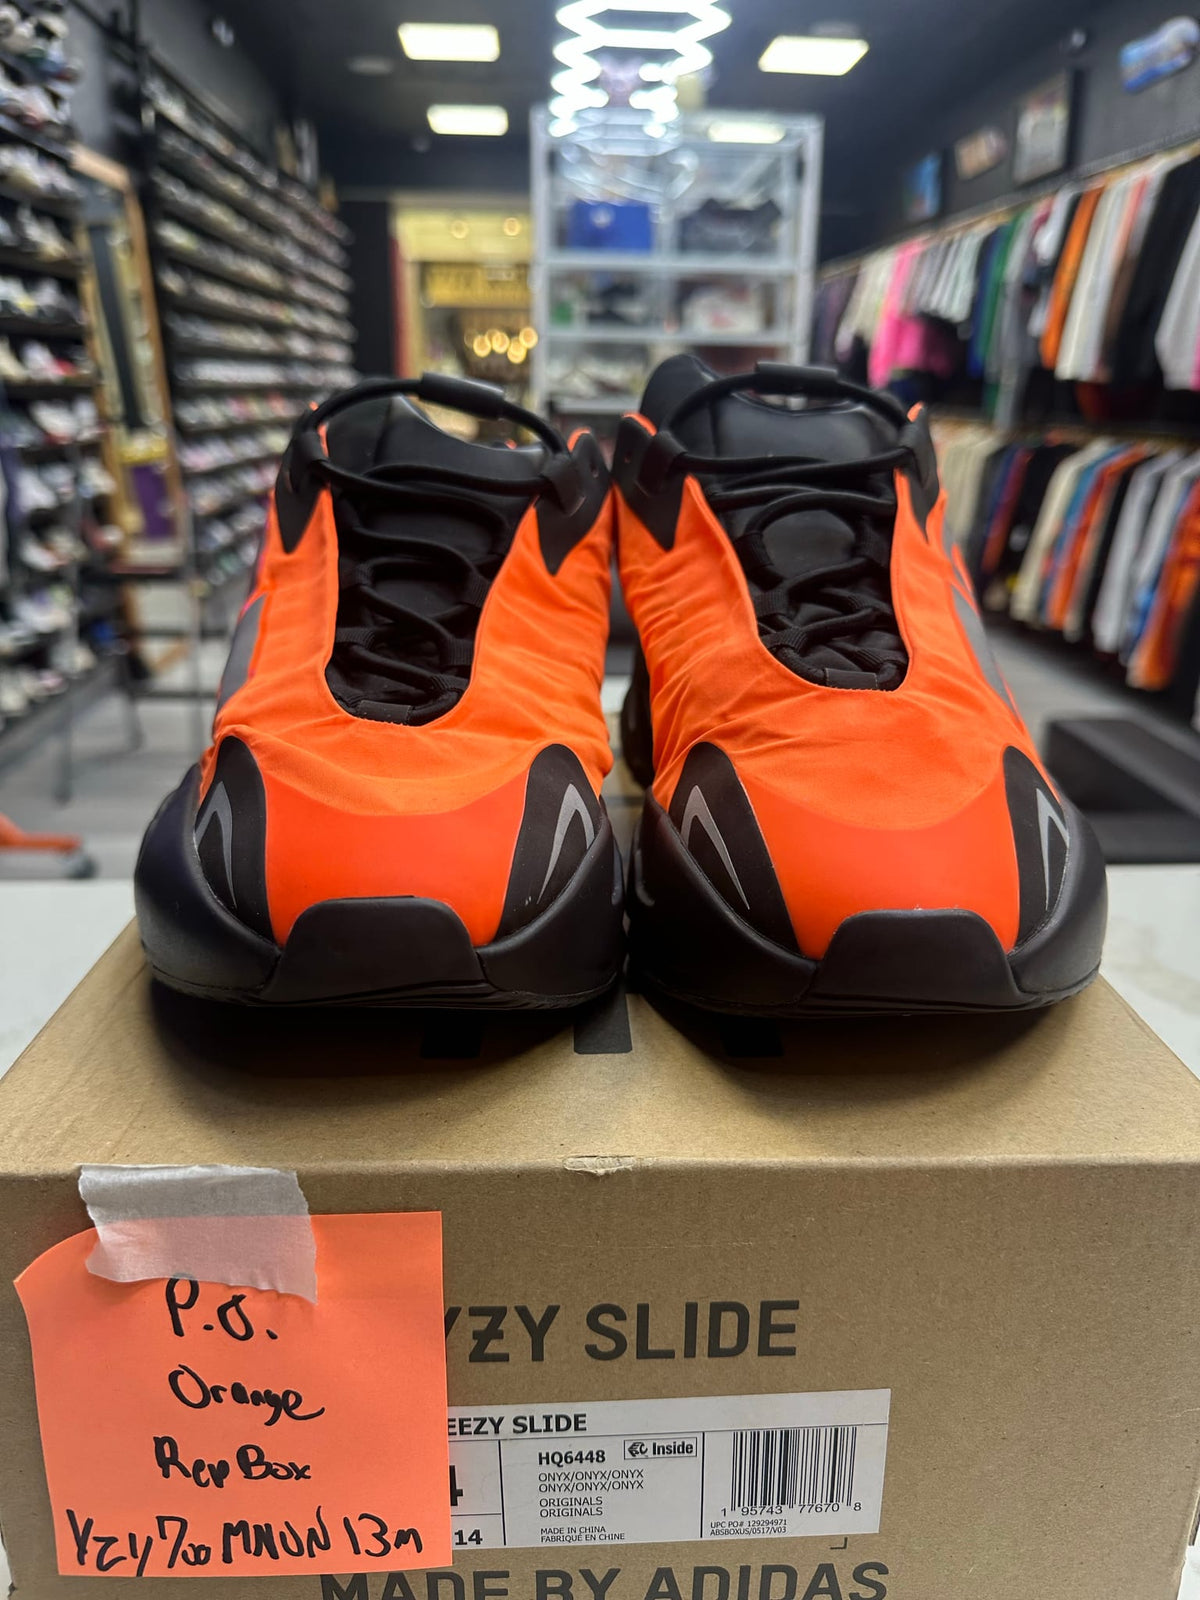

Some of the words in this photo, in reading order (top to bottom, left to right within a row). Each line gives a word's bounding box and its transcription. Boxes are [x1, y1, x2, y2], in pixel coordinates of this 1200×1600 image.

[584, 1299, 800, 1361] SLIDE
[168, 1364, 325, 1426] Orange
[512, 1413, 587, 1434] SLIDE
[652, 1440, 694, 1456] Inside
[236, 1444, 312, 1481] Box
[538, 1449, 606, 1467] HQ6448
[538, 1469, 644, 1483] ONYX/ONYX/ONYX
[538, 1480, 644, 1493] ONYX/ONYX/ONYX
[539, 1496, 603, 1508] ORIGINALS
[721, 1507, 727, 1517] 1
[741, 1504, 783, 1516] 95743
[799, 1502, 840, 1514] 77670
[853, 1502, 862, 1511] 8
[540, 1507, 603, 1518] ORIGINALS
[540, 1527, 565, 1535] MADE
[579, 1526, 606, 1534] CHINA
[710, 1521, 726, 1529] UPC
[728, 1520, 743, 1528] PO#
[747, 1519, 787, 1527] 129294971
[710, 1527, 787, 1536] ABSBOXUS/0517/V03
[454, 1529, 483, 1546] 14
[585, 1533, 596, 1541] EN
[598, 1532, 625, 1541] CHINE
[536, 1567, 621, 1600] BY
[644, 1561, 889, 1600] ADIDAS
